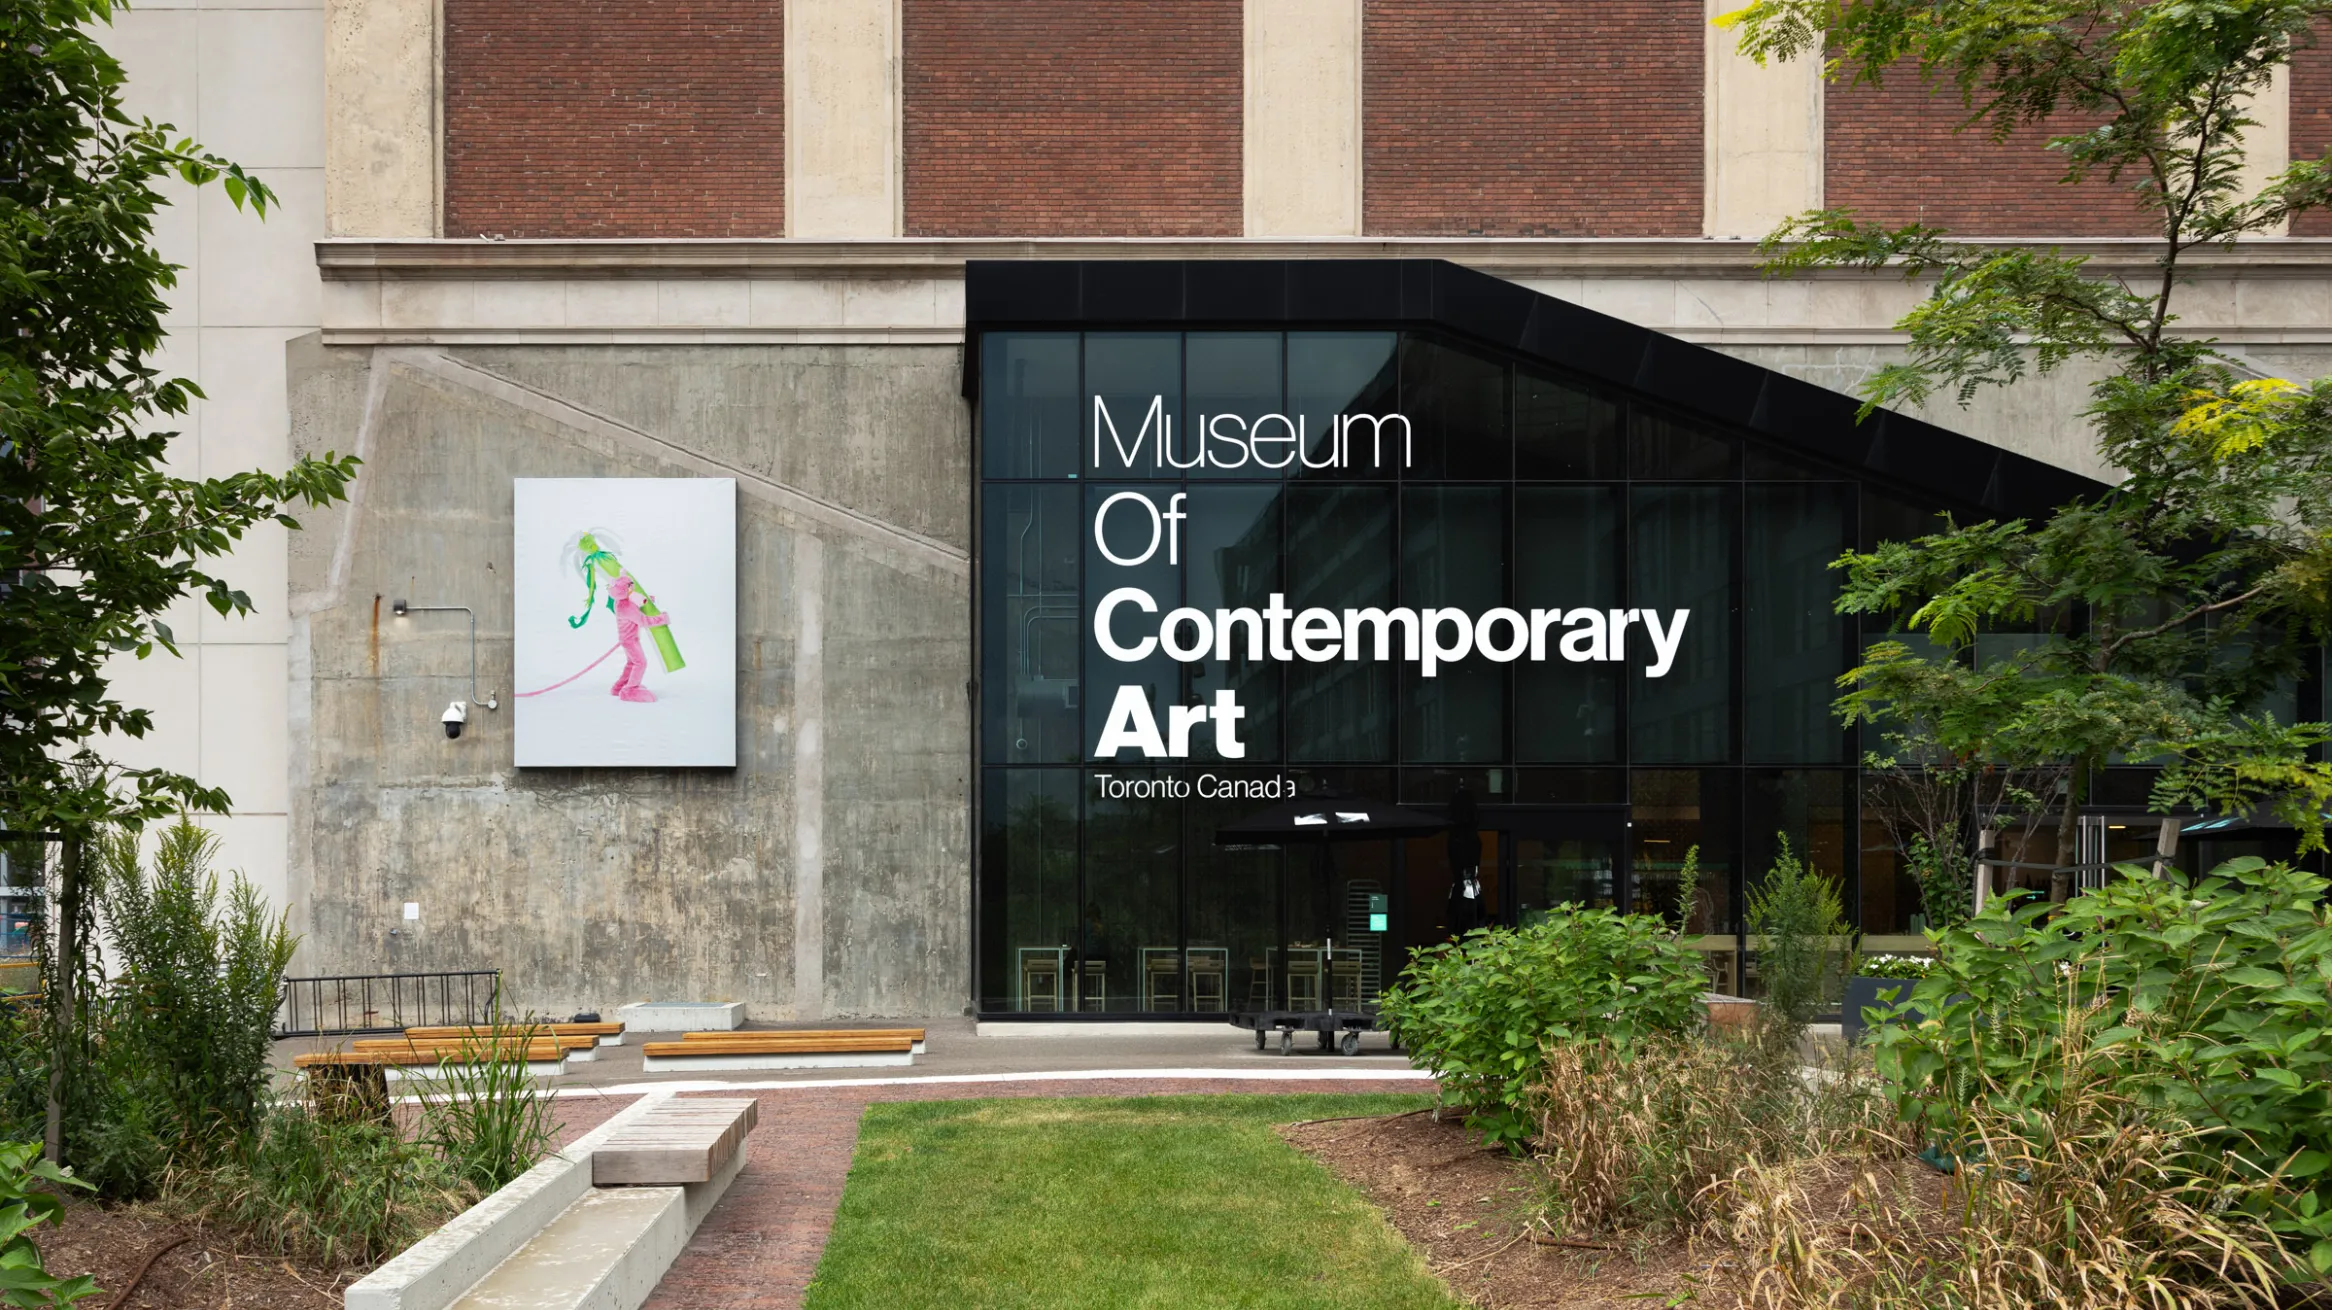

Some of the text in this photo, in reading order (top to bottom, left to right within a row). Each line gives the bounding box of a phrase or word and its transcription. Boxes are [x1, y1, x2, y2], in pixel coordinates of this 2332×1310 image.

[1094, 395, 1412, 469] Museum
[1094, 491, 1188, 567] Of
[1094, 587, 1691, 678] Contemporary
[1093, 685, 1246, 759] Art
[1094, 774, 1190, 799] Toronto
